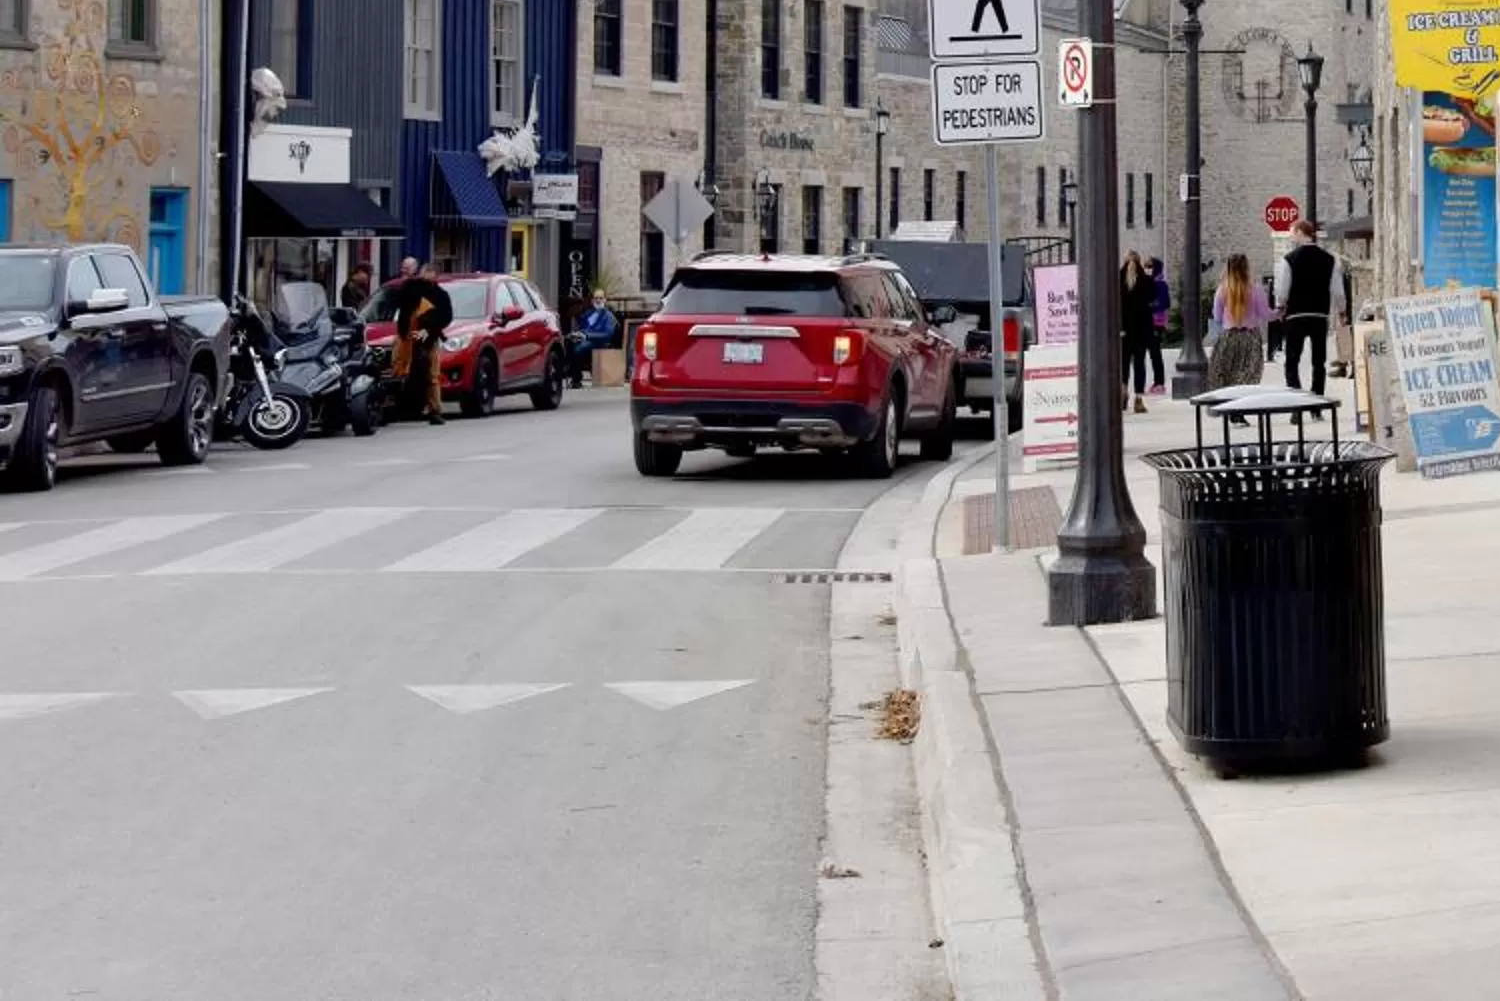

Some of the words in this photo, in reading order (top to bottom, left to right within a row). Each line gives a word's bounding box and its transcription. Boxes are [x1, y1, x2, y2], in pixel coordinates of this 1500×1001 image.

[1408, 14, 1435, 30] ICE
[1439, 11, 1496, 29] CREAM
[1449, 47, 1499, 64] GRILL
[953, 75, 987, 96] STOP
[995, 74, 1022, 94] FOR
[943, 106, 1036, 130] PEDESTRIANS
[1266, 209, 1298, 221] STOP
[568, 249, 583, 298] OPEN
[1391, 310, 1437, 339] Frozen
[1405, 367, 1434, 391] ICE
[1437, 358, 1493, 385] CREAM
